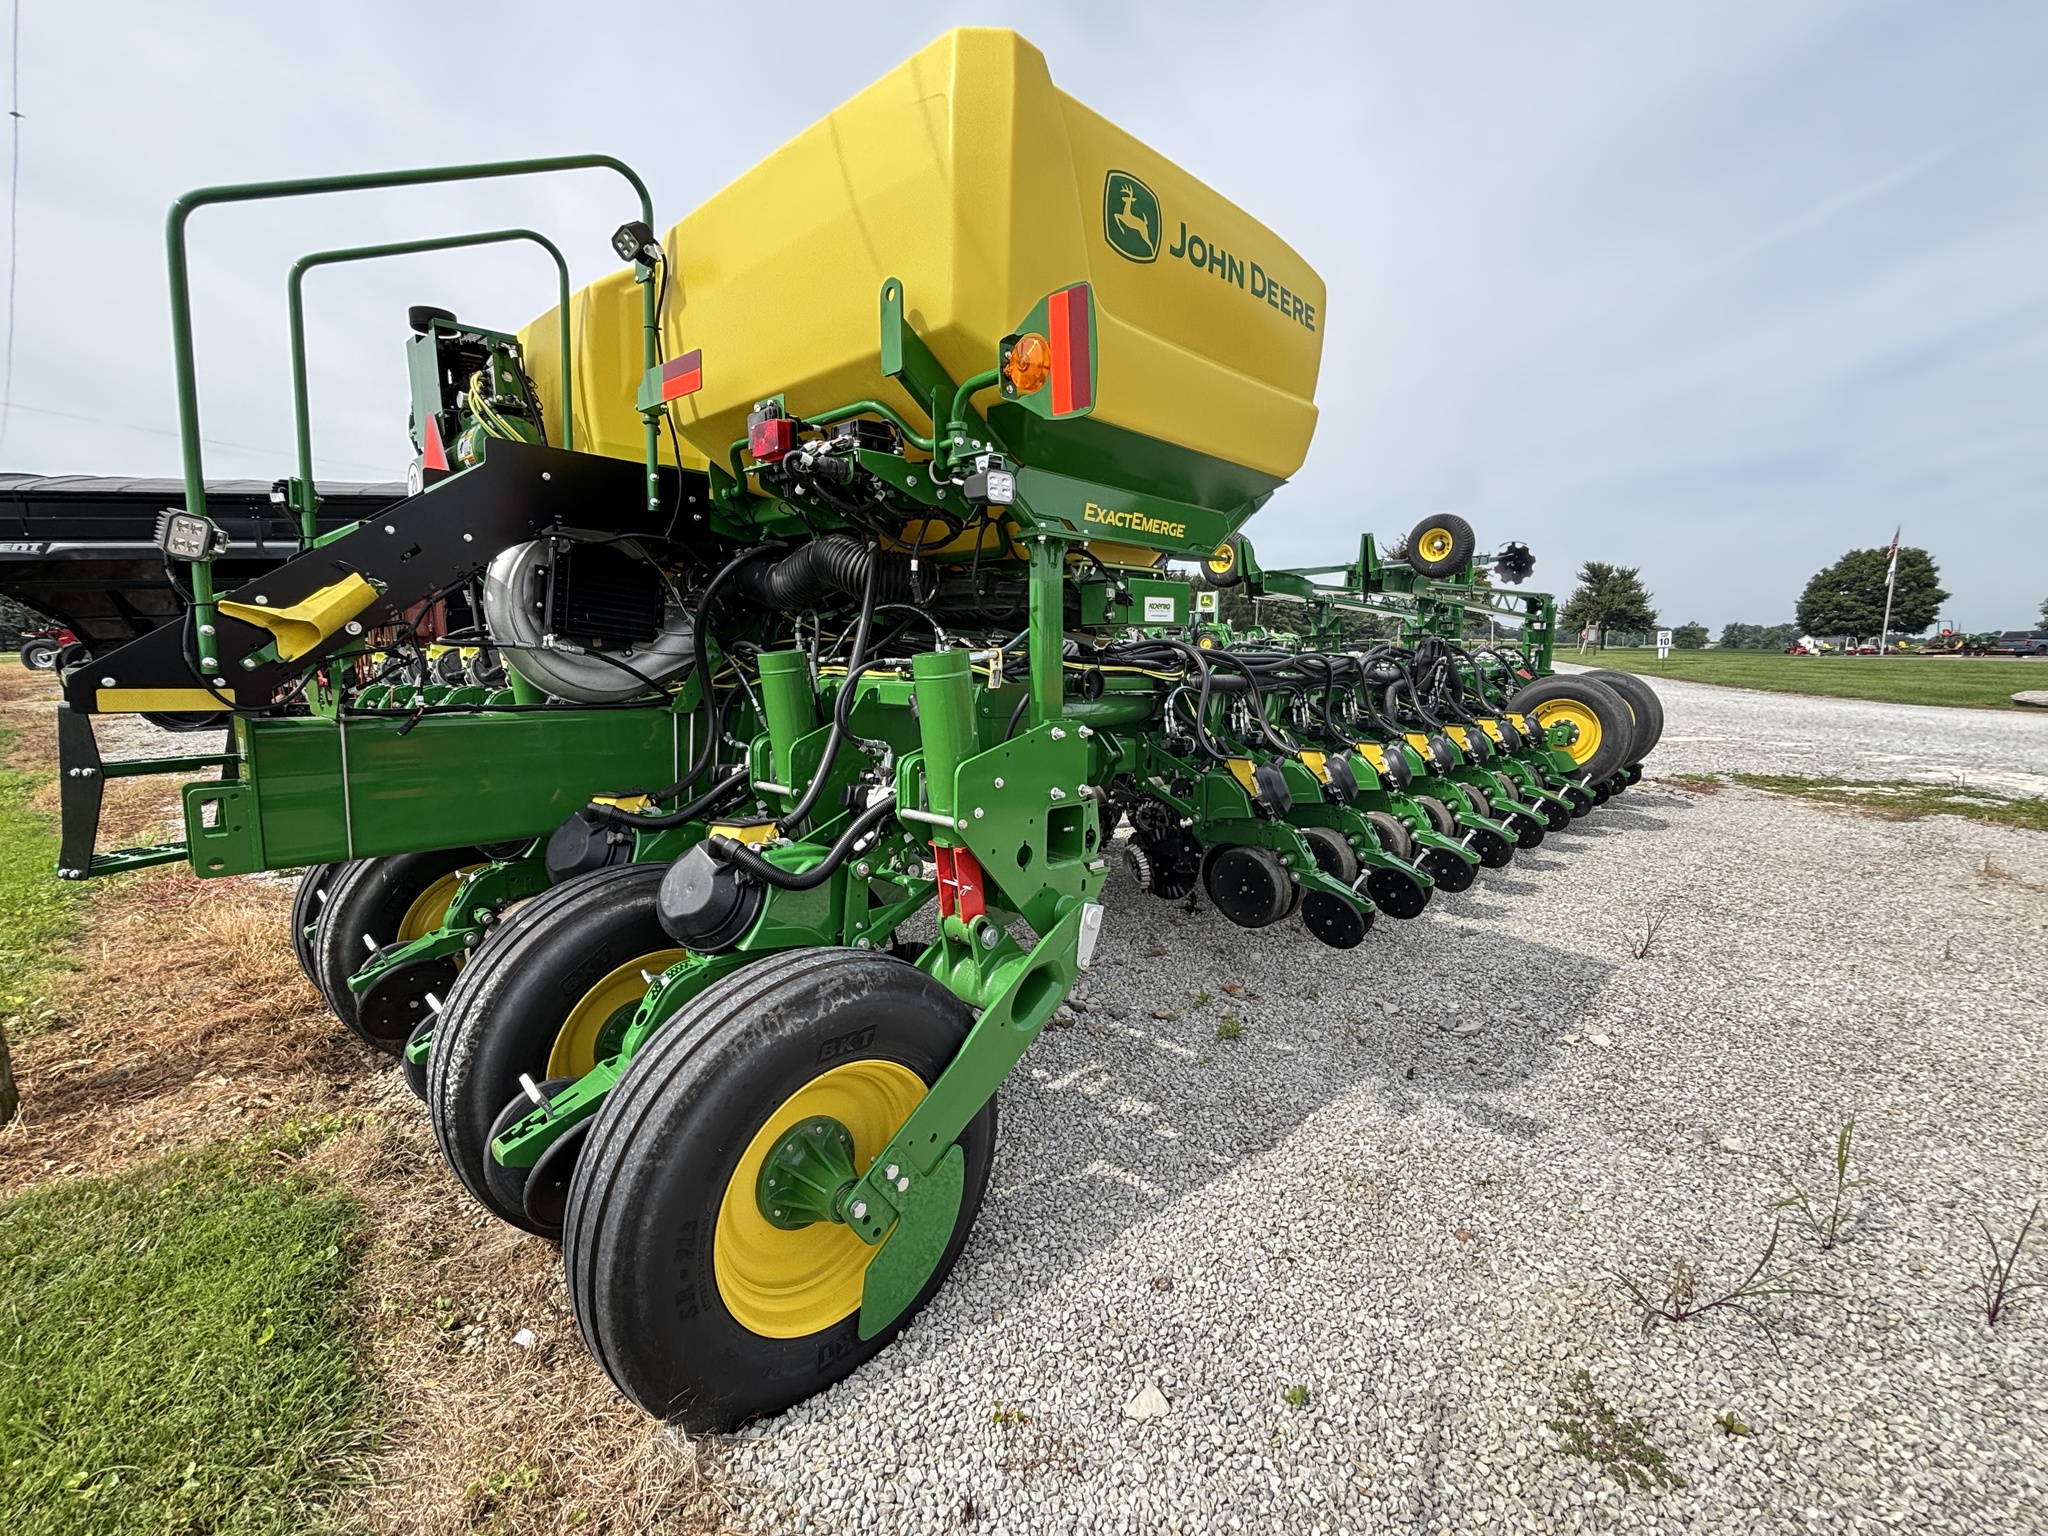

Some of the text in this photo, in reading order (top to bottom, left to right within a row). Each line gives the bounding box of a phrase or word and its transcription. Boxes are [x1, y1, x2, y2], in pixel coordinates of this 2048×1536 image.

[1169, 221, 1316, 333] JOHN DEERE
[1083, 502, 1186, 539] EXACTEMERGE
[1659, 637, 1670, 646] 10
[817, 1025, 877, 1065] BKT
